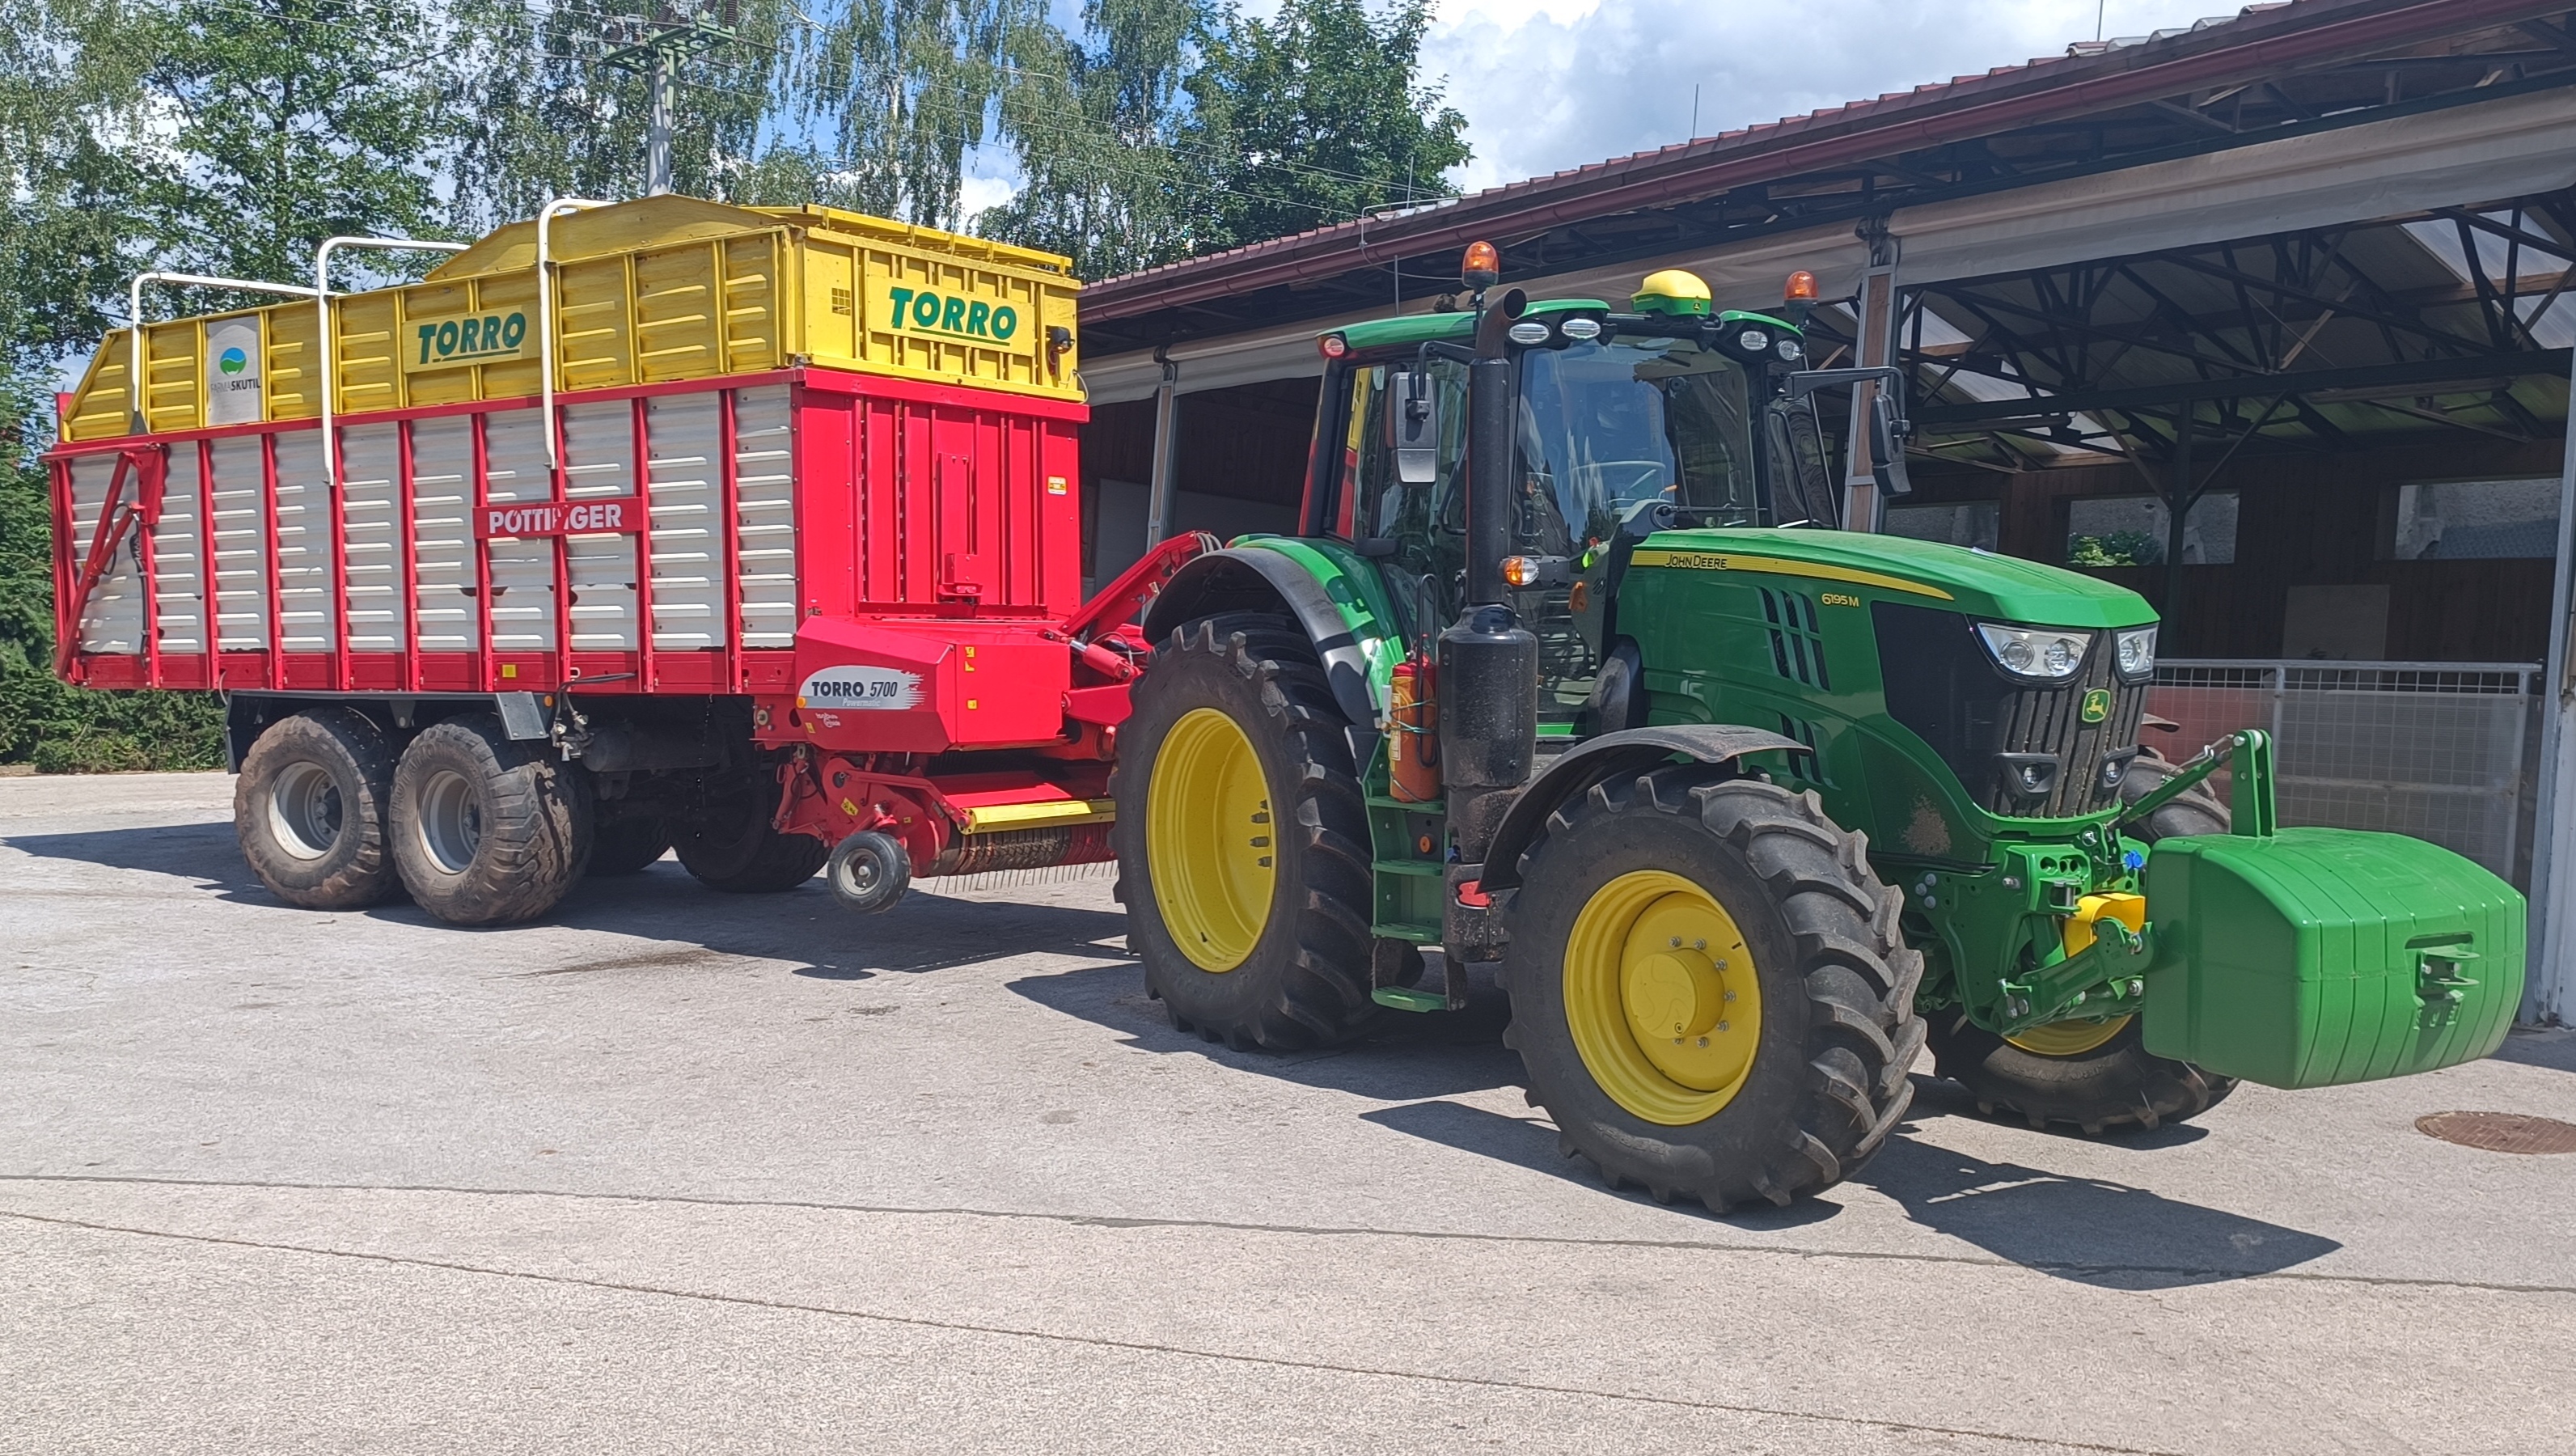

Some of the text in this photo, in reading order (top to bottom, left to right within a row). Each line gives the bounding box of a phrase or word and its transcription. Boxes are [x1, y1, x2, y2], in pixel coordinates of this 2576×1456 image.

[889, 286, 1017, 340] TORRO
[418, 312, 526, 364] TORRO
[811, 681, 898, 696] TORRO 5700
[842, 697, 881, 707] Powermatic
